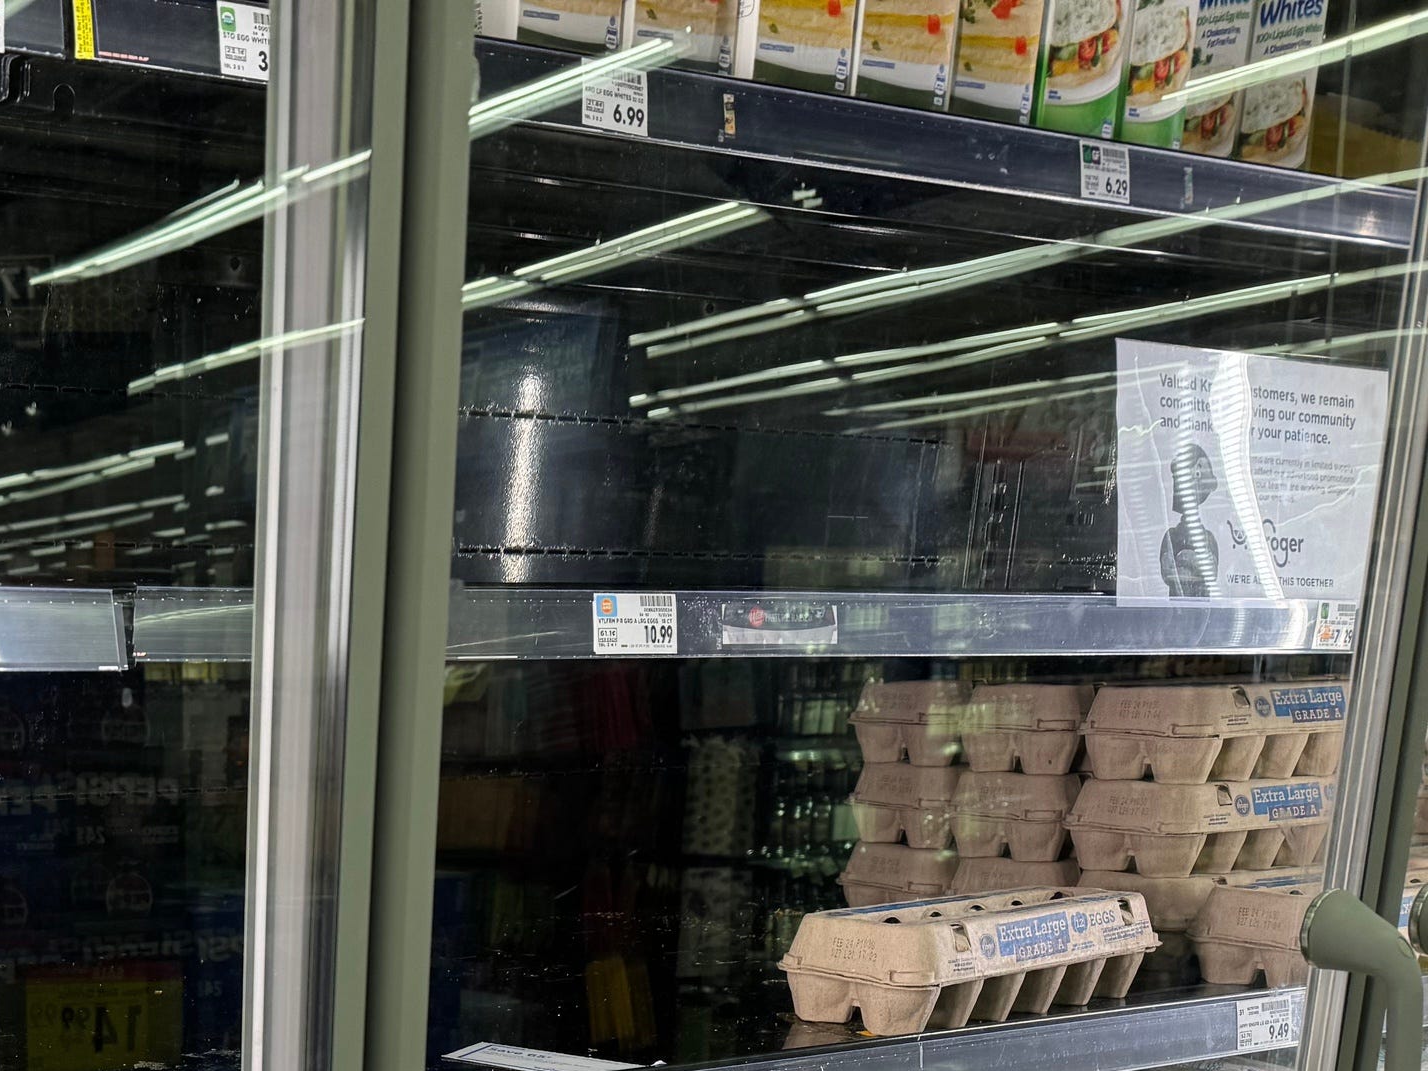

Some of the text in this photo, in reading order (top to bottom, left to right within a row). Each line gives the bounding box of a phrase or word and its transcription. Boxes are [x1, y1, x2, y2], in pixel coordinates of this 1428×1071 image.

[1294, 26, 1305, 37] Egg
[613, 104, 645, 127] 6.99
[1106, 177, 1128, 196] 6.29
[1301, 392, 1355, 409] we remain
[1160, 415, 1180, 429] and
[1278, 409, 1356, 430] our community
[1258, 427, 1331, 445] your patience.
[1279, 577, 1295, 586] THIS
[1297, 577, 1334, 587] TOGETHER
[644, 625, 673, 644] 10.99
[1274, 689, 1342, 706] Extra Large
[1295, 708, 1342, 720] GRADE A
[1253, 787, 1320, 804] Extra Large
[1310, 805, 1318, 815] A
[999, 909, 1116, 942] Extra Large 12 EGGS
[1018, 938, 1066, 959] GRADE A
[1269, 1022, 1289, 1040] 9.49
